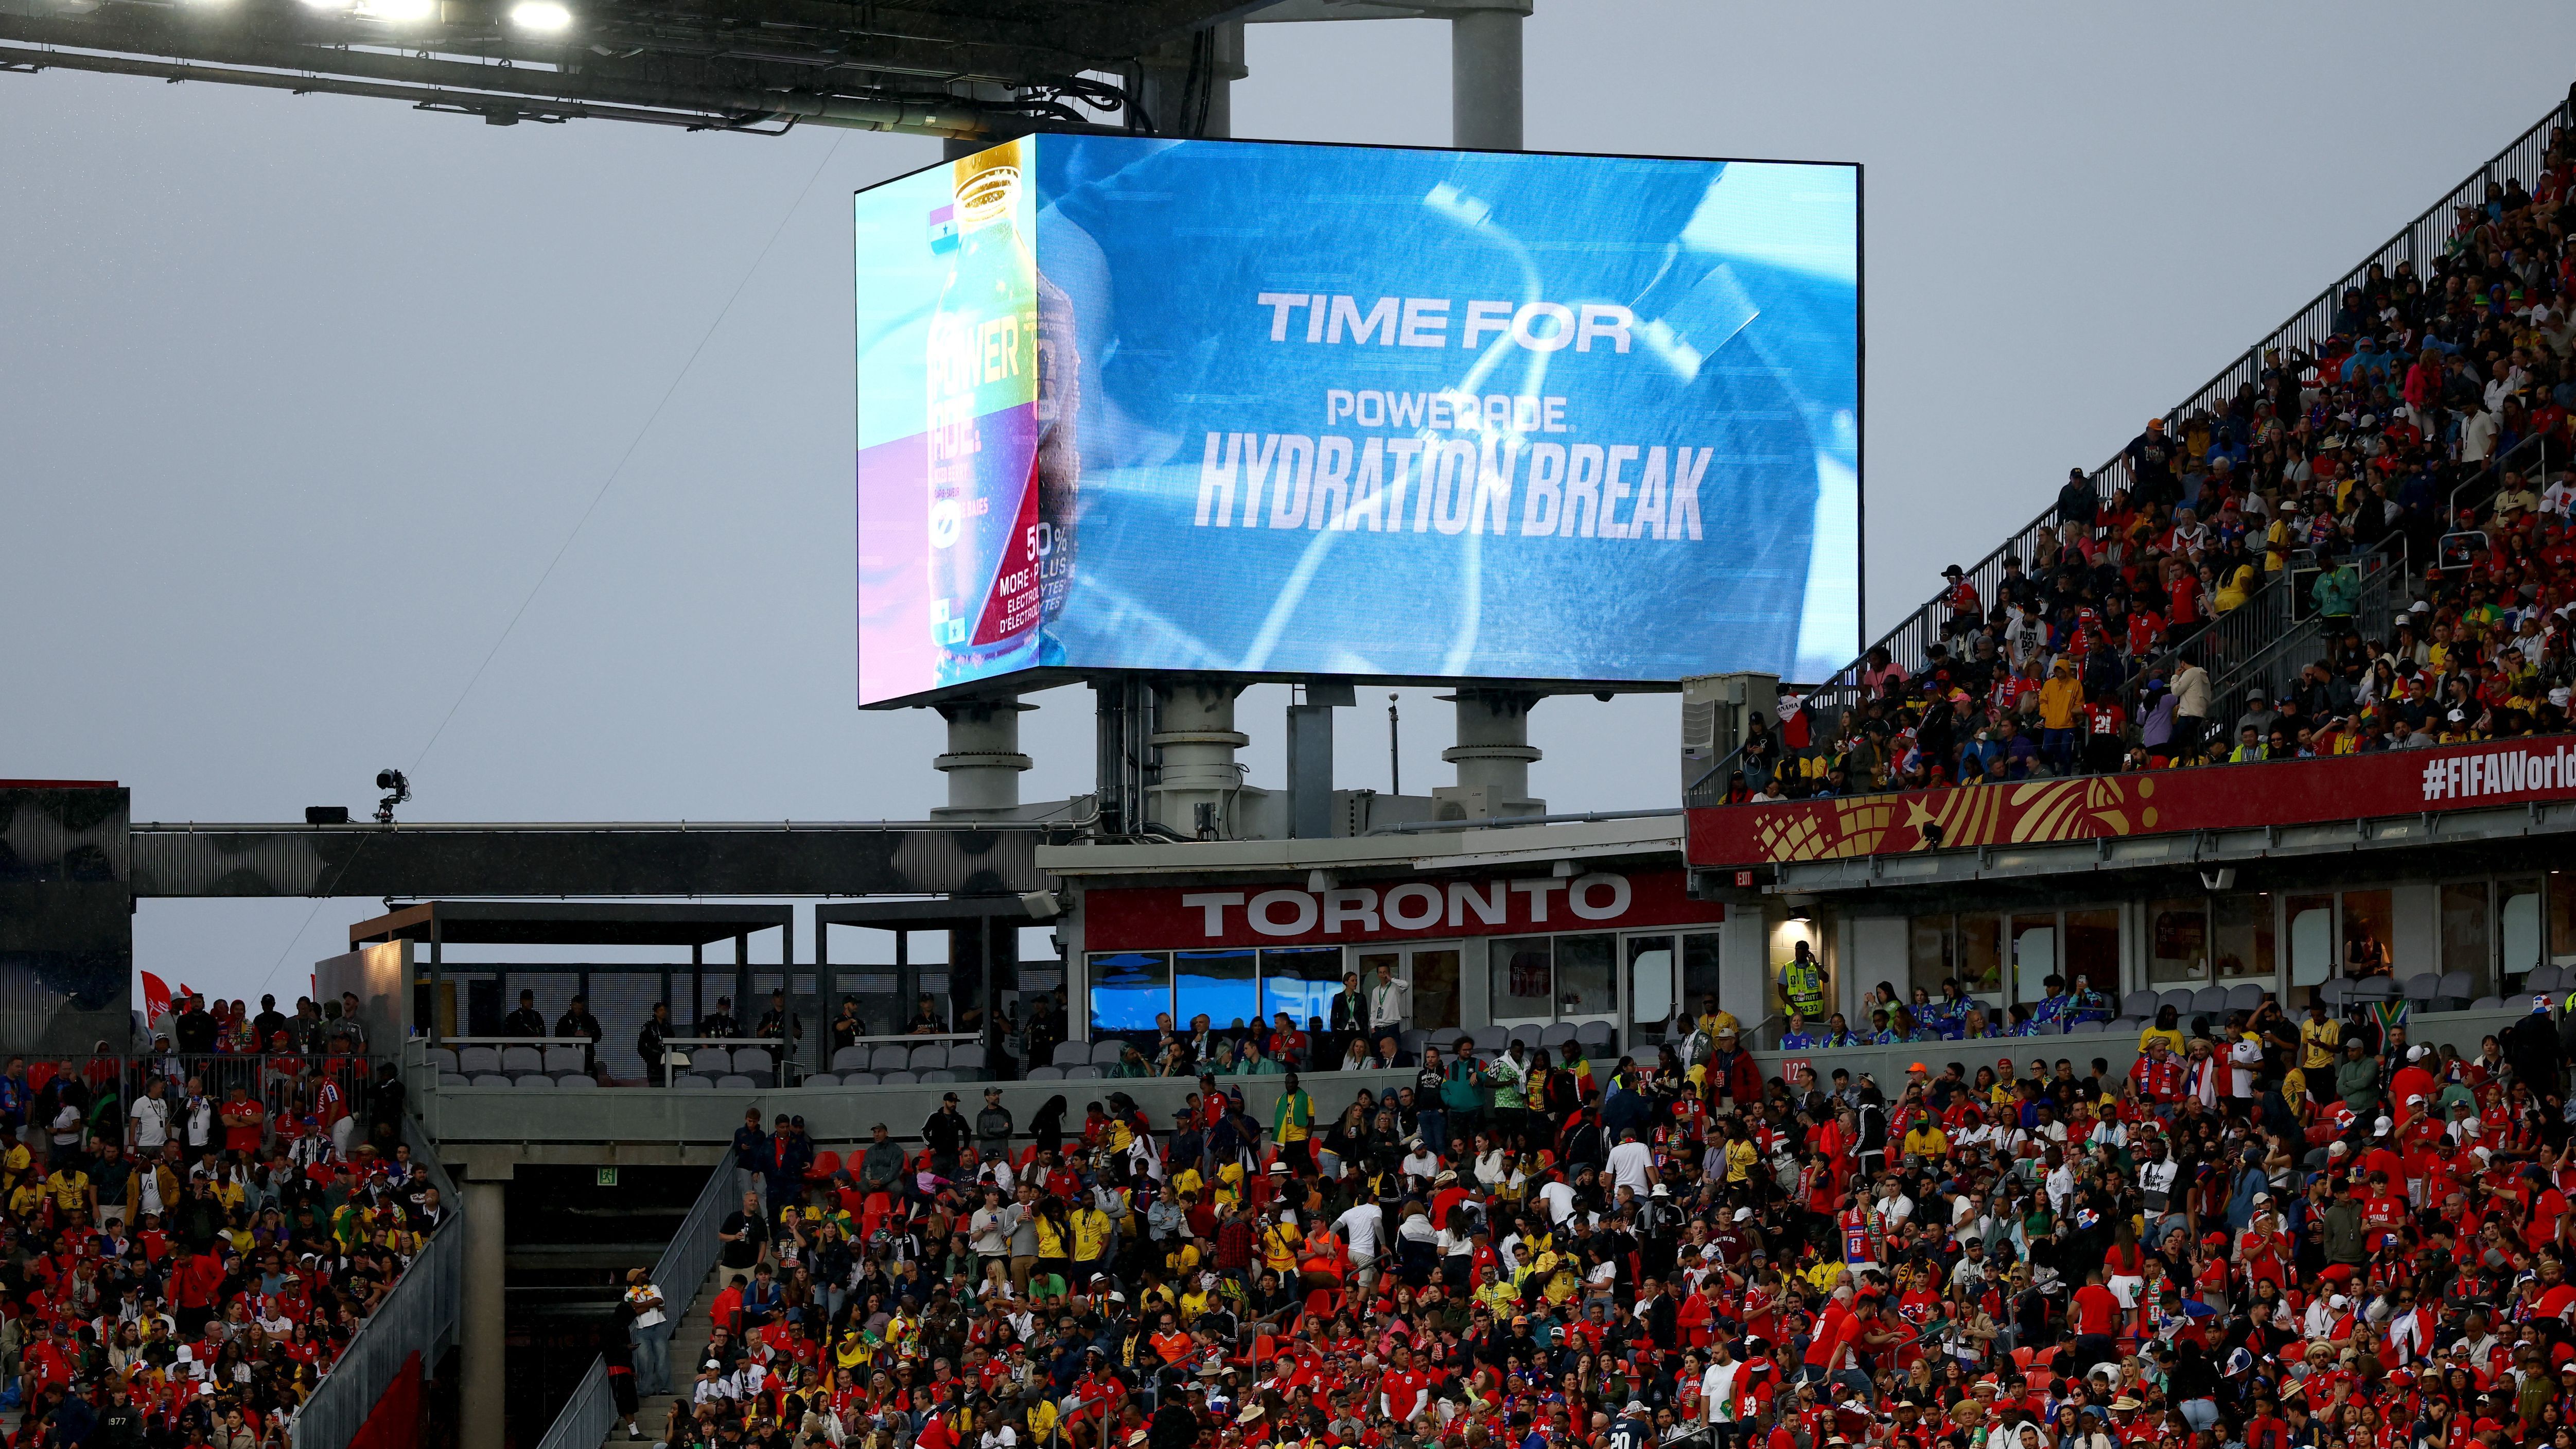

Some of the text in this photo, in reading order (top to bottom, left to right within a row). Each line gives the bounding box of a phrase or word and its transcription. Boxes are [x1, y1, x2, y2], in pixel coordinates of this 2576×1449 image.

[1257, 291, 1634, 353] TIME FOR
[1194, 431, 1714, 540] HYDRATION BREAK
[967, 497, 988, 518] BAIES
[1000, 557, 1066, 597] MORE PLUS
[2020, 631, 2037, 640] JUST
[2094, 715, 2112, 734] 21
[1738, 872, 1750, 885] EXIT
[1182, 872, 1632, 937] TORONTO
[1421, 1073, 1442, 1082] HOLLISTER
[1712, 1236, 1737, 1245] HARVARD
[75, 1245, 83, 1255] 18
[108, 1417, 127, 1426] 1977
[1610, 1431, 1631, 1449] 20
